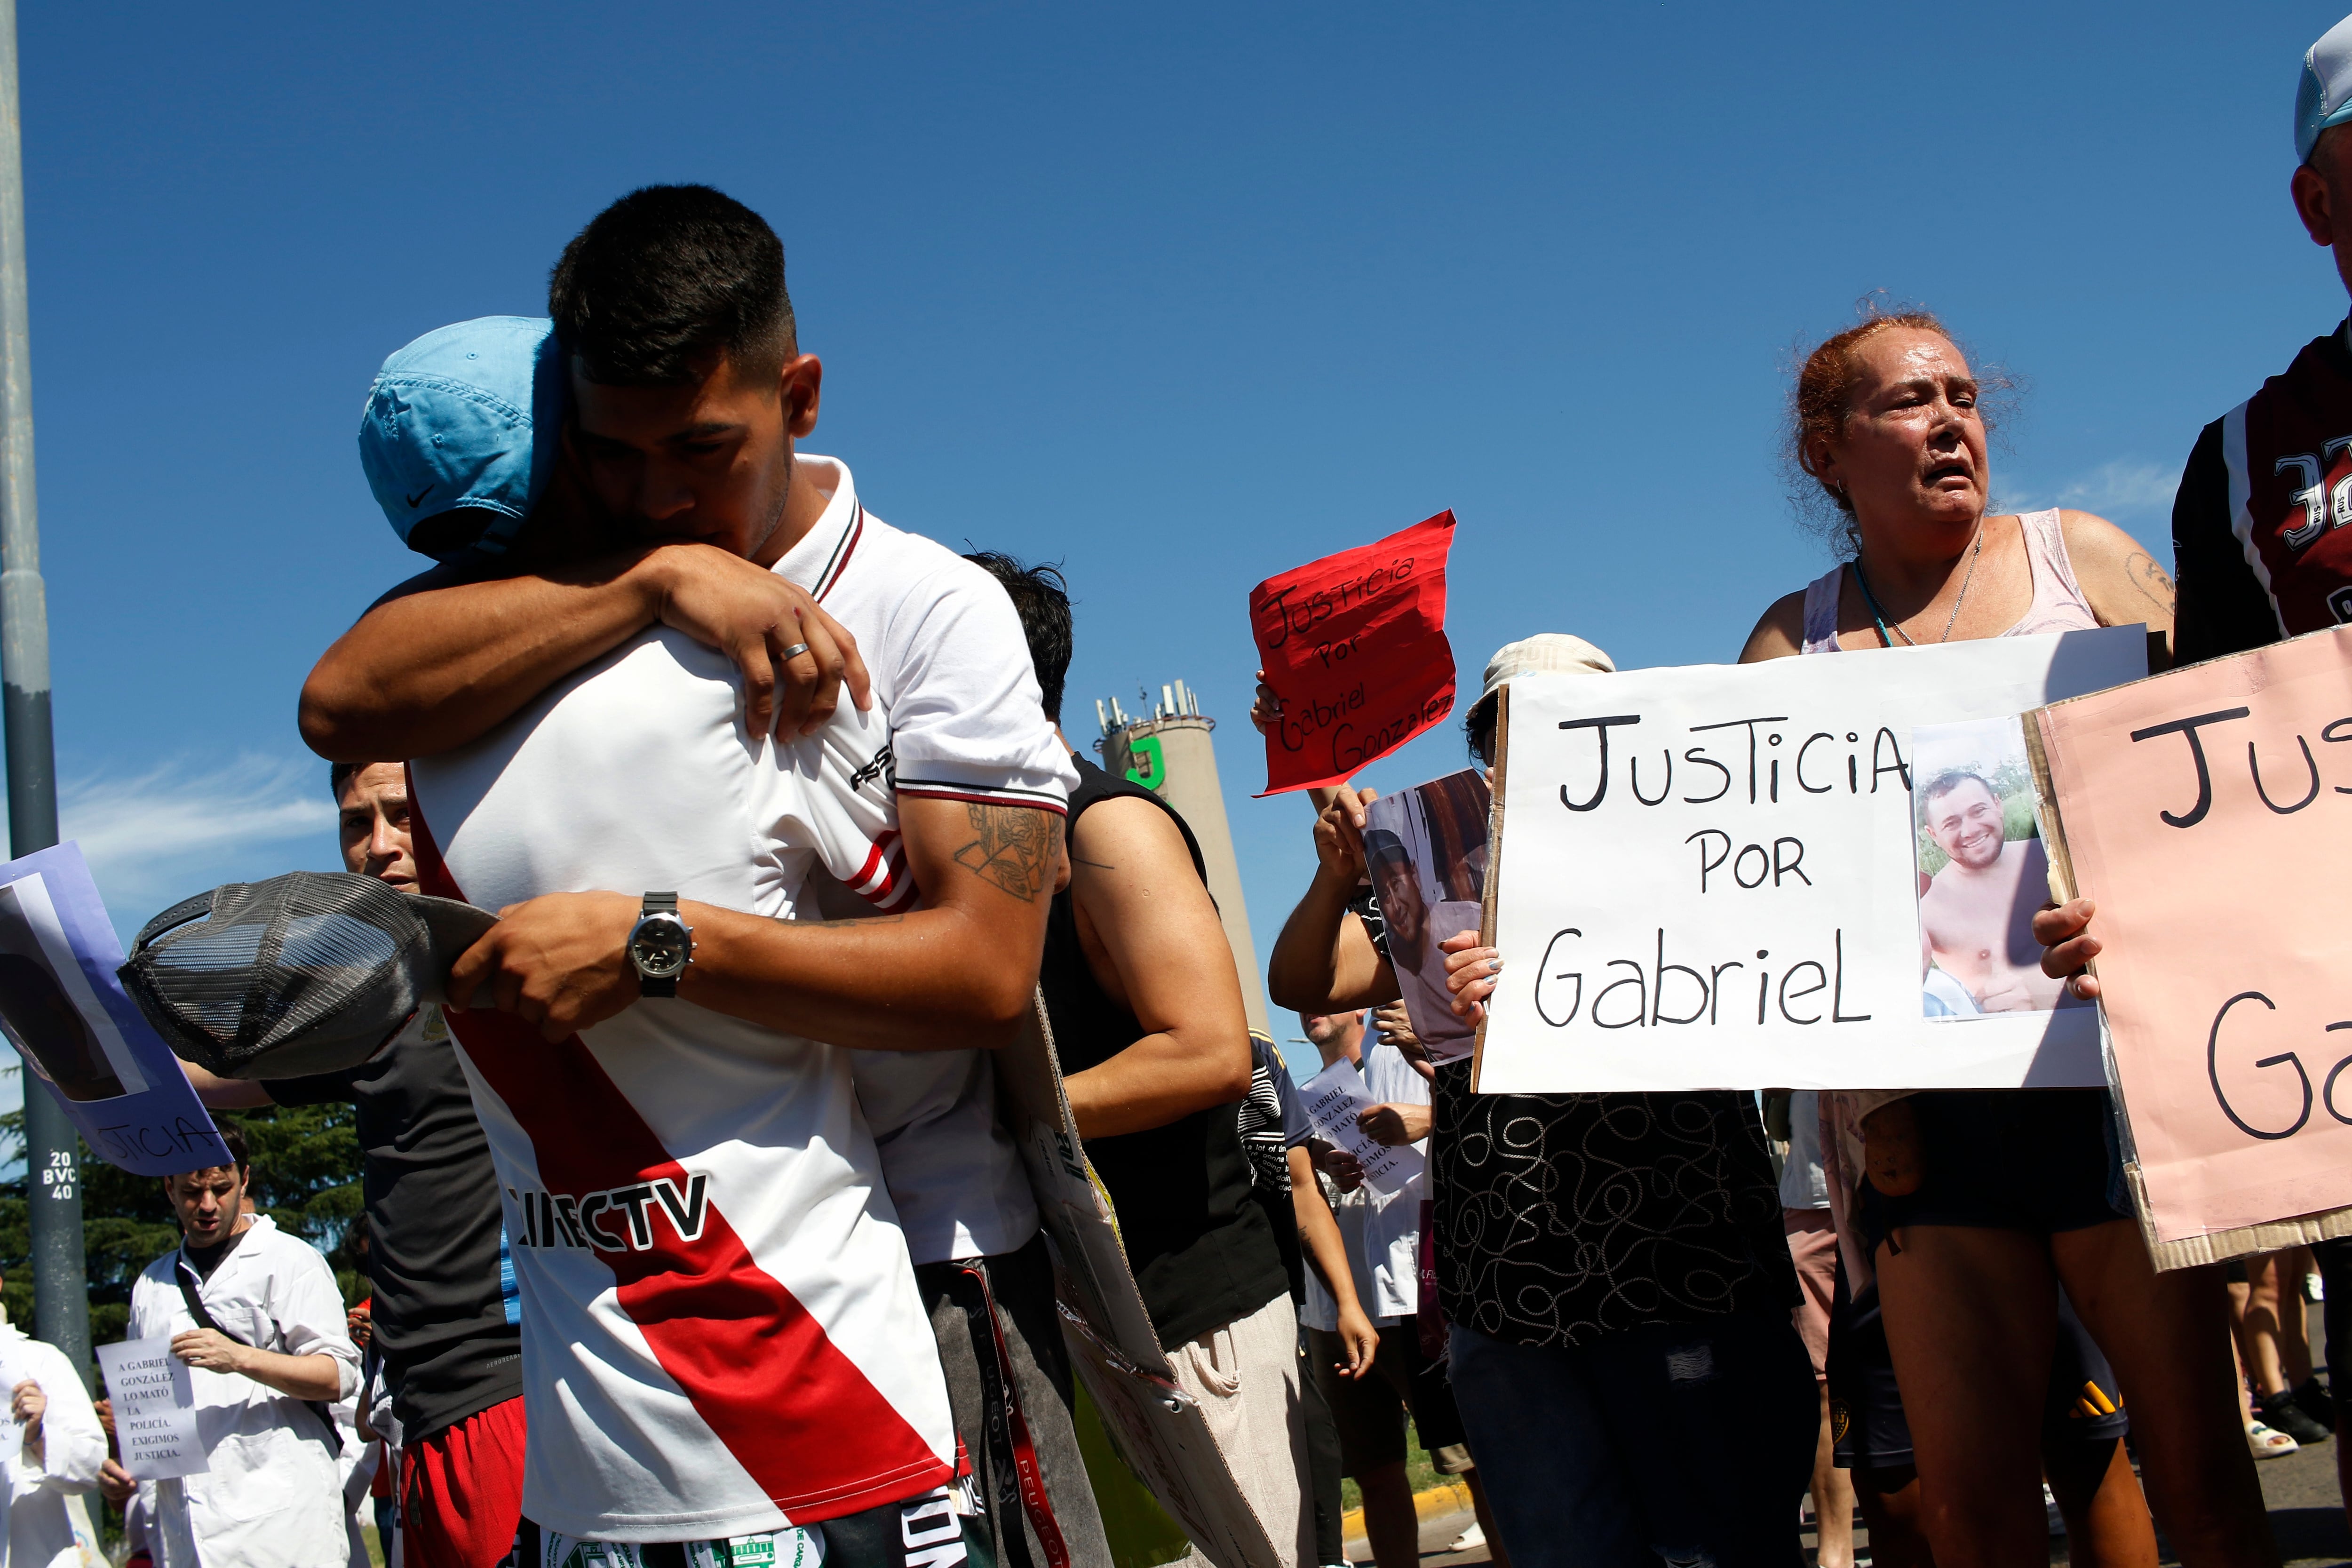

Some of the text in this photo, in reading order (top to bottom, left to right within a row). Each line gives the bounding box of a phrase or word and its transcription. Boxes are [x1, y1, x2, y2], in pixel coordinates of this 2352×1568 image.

[1332, 693, 1454, 774] Gonzalez
[1685, 829, 1812, 893] POR
[1309, 1086, 1346, 1114] GABRIEL
[1332, 1111, 1358, 1135] MATÓ
[97, 1117, 218, 1161] STICIA
[1351, 1138, 1377, 1156] ICÍA.
[50, 1152, 71, 1167] 20
[1263, 1154, 1285, 1162] gonna
[1362, 1145, 1392, 1168] GIMOS
[1263, 1160, 1282, 1172] going
[43, 1167, 76, 1185] BVC
[52, 1185, 72, 1200] 40
[127, 1358, 172, 1371] GABRIEL
[120, 1371, 175, 1386] GONZÁLEZ
[124, 1386, 169, 1402] LO MATÓ
[127, 1407, 141, 1416] LA
[130, 1417, 171, 1431] POLICÍA.
[132, 1434, 180, 1447] EXIGIMOS
[135, 1449, 181, 1461] JUSTICIA.
[1020, 1460, 1064, 1568] PEUGEOT
[793, 1543, 805, 1568] CARG
